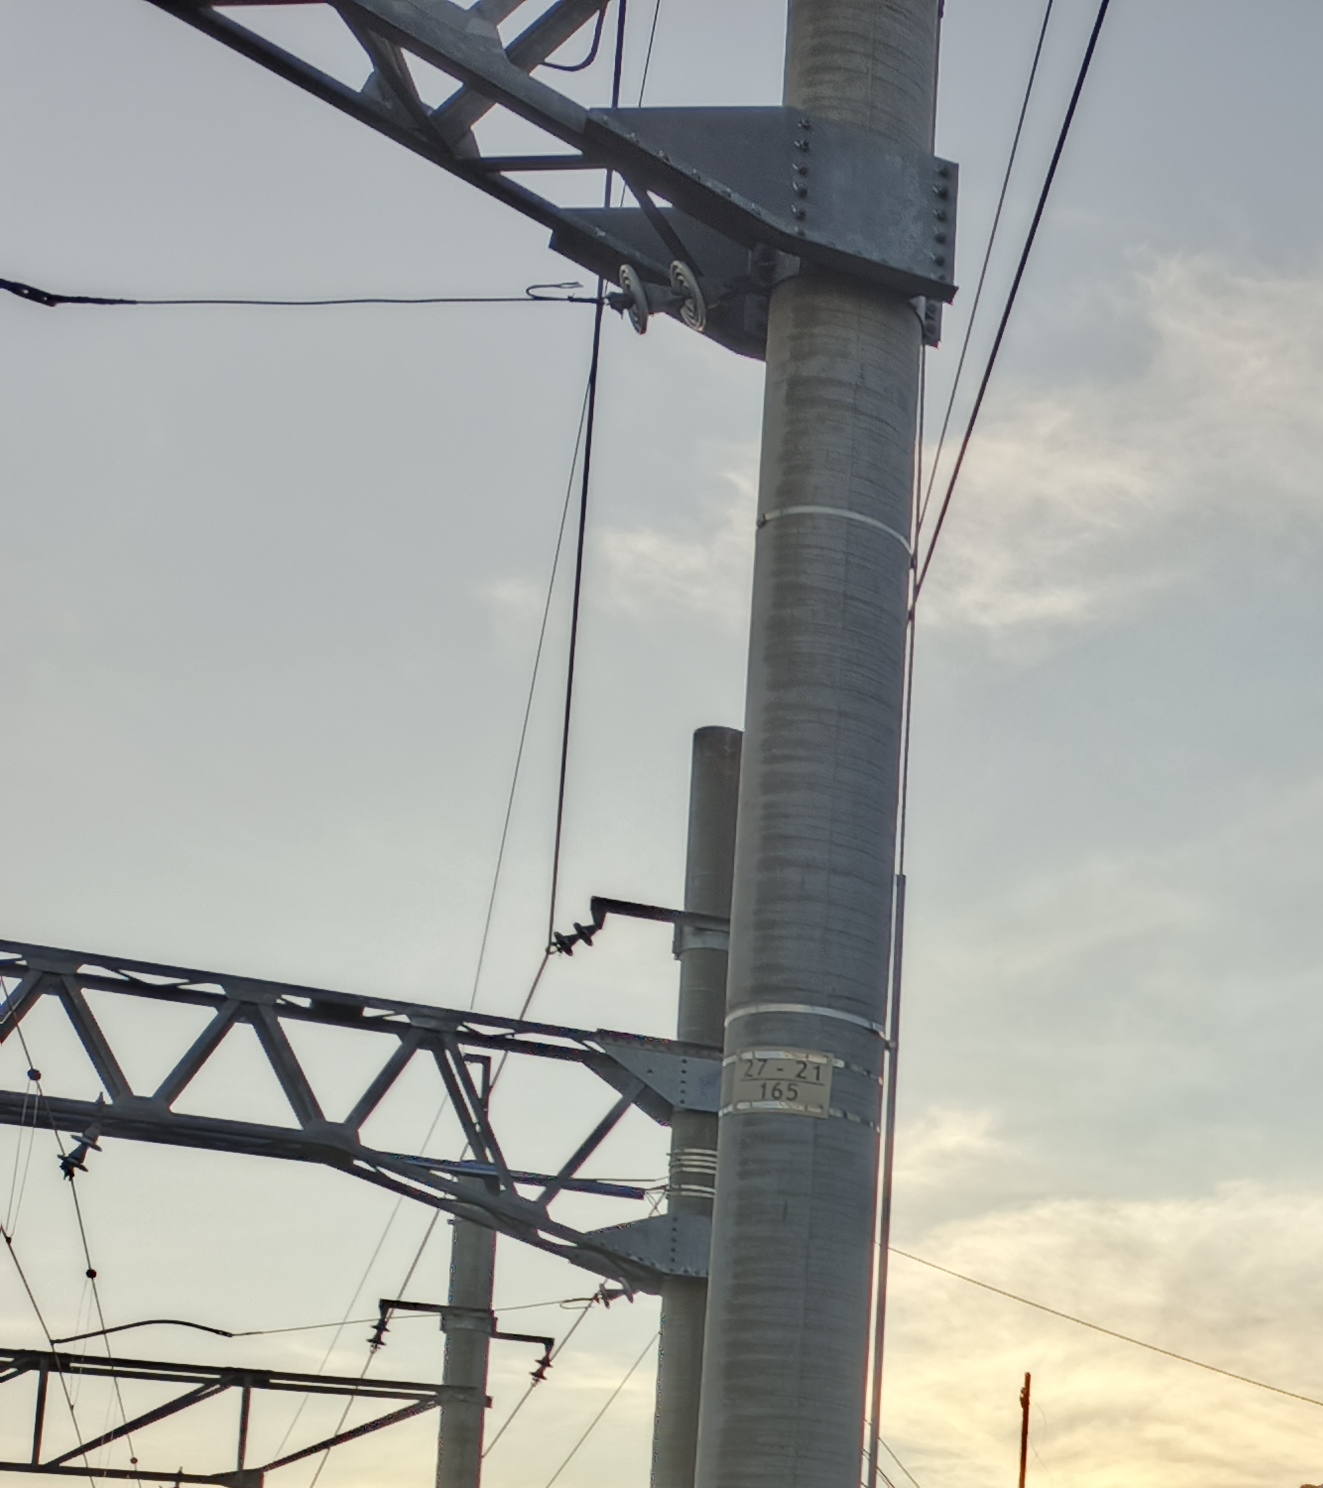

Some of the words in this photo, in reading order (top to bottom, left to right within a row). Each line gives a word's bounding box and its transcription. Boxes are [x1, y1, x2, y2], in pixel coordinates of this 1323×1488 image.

[744, 1060, 768, 1077] 27
[796, 1061, 821, 1081] 21
[760, 1082, 798, 1101] 165
